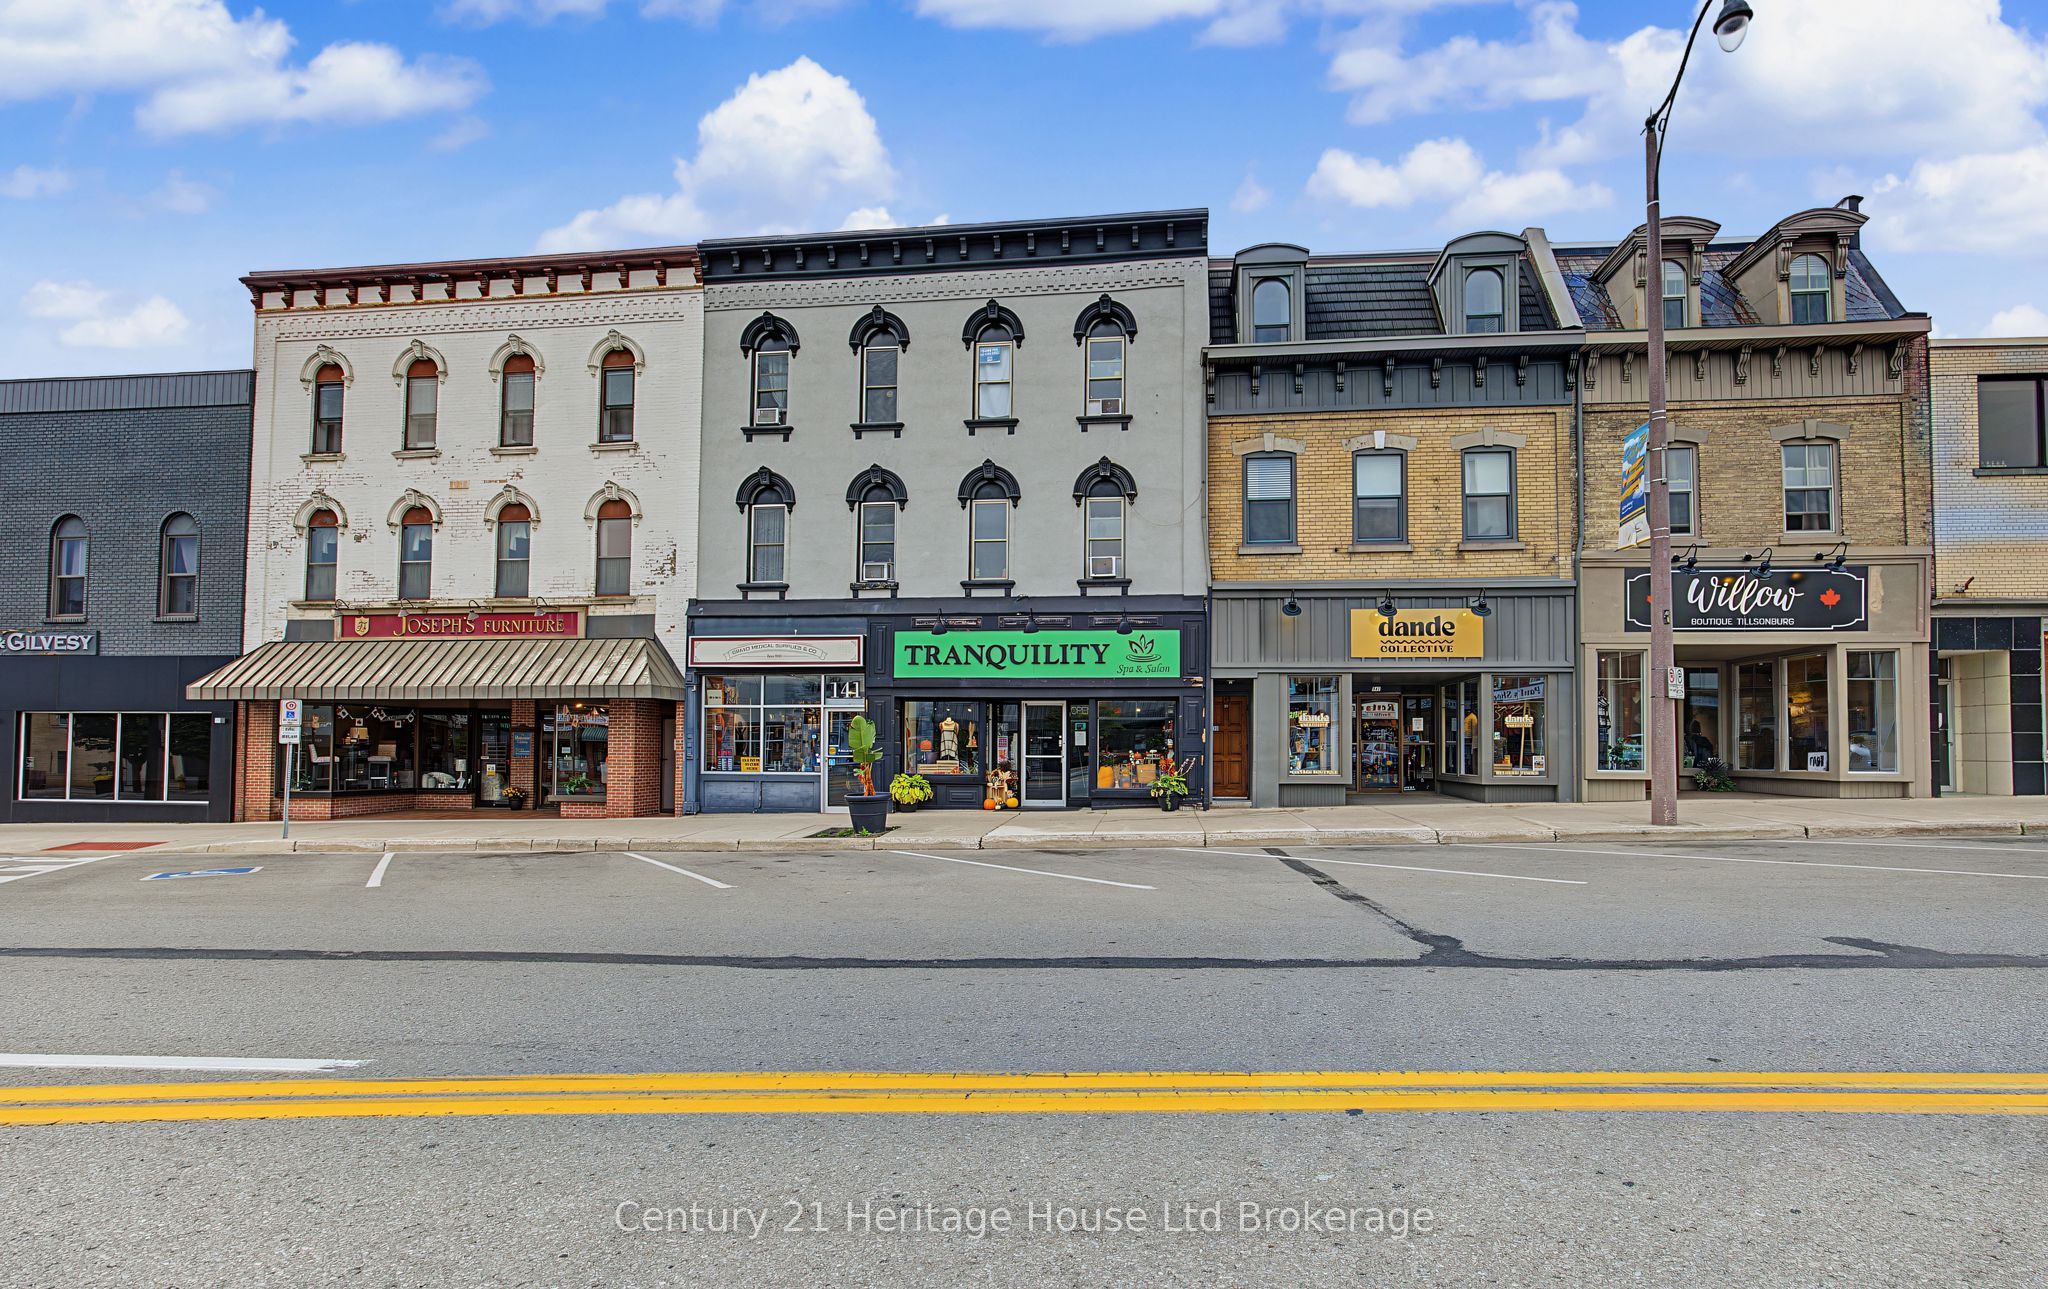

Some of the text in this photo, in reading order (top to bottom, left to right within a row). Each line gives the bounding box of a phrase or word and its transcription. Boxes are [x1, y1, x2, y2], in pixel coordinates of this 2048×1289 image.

[1687, 575, 1805, 615] Willow
[483, 618, 565, 634] FURNITURE
[1378, 615, 1456, 637] dande
[1691, 617, 1795, 626] BOUTIQUE TILLSONBURG
[6, 632, 93, 651] GILVESY
[1380, 645, 1454, 653] COLLECTIVE
[904, 643, 1110, 670] TRANQUILITY
[1116, 664, 1170, 676] Spa & Salon
[829, 681, 861, 698] 141
[1299, 712, 1330, 722] dande
[1504, 714, 1534, 723] dande
